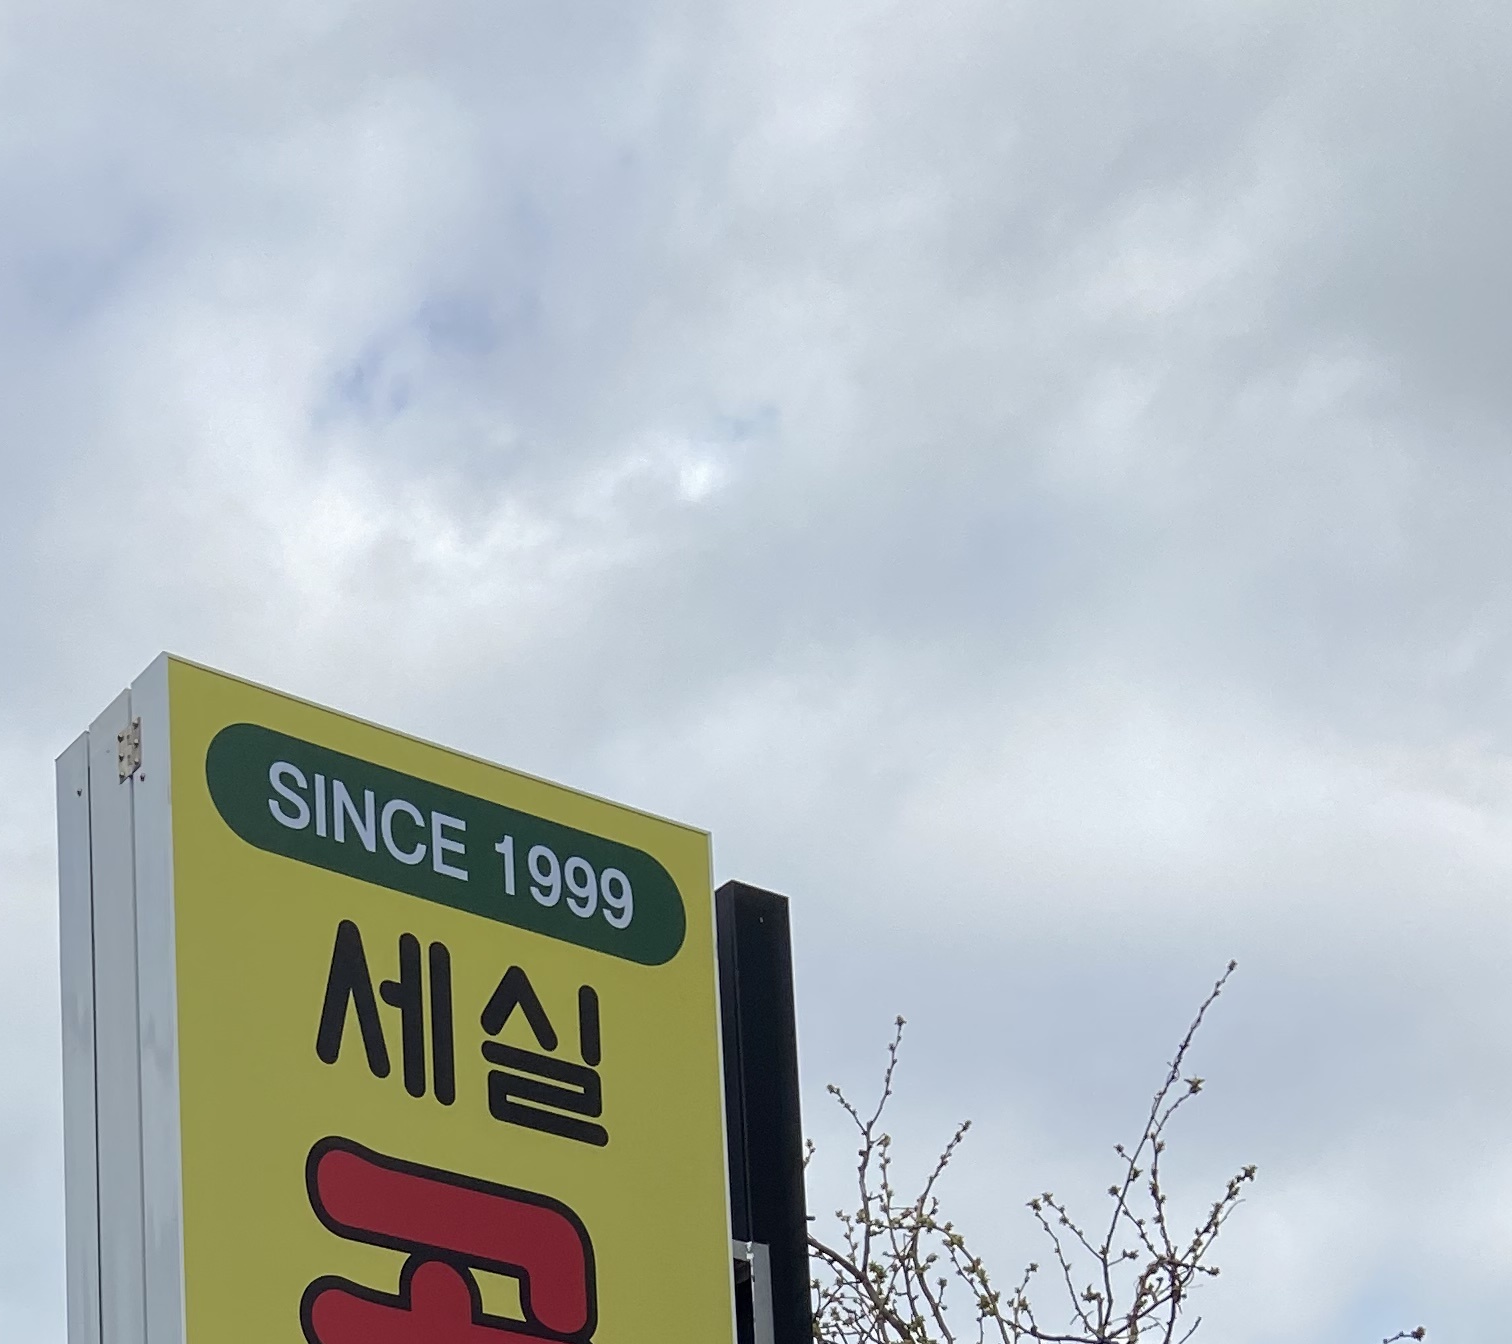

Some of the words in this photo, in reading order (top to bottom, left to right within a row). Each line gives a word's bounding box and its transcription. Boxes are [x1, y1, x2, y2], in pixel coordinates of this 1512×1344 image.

[267, 761, 468, 882] SINCE
[495, 834, 634, 930] 1999
[315, 919, 609, 1147] 세실
